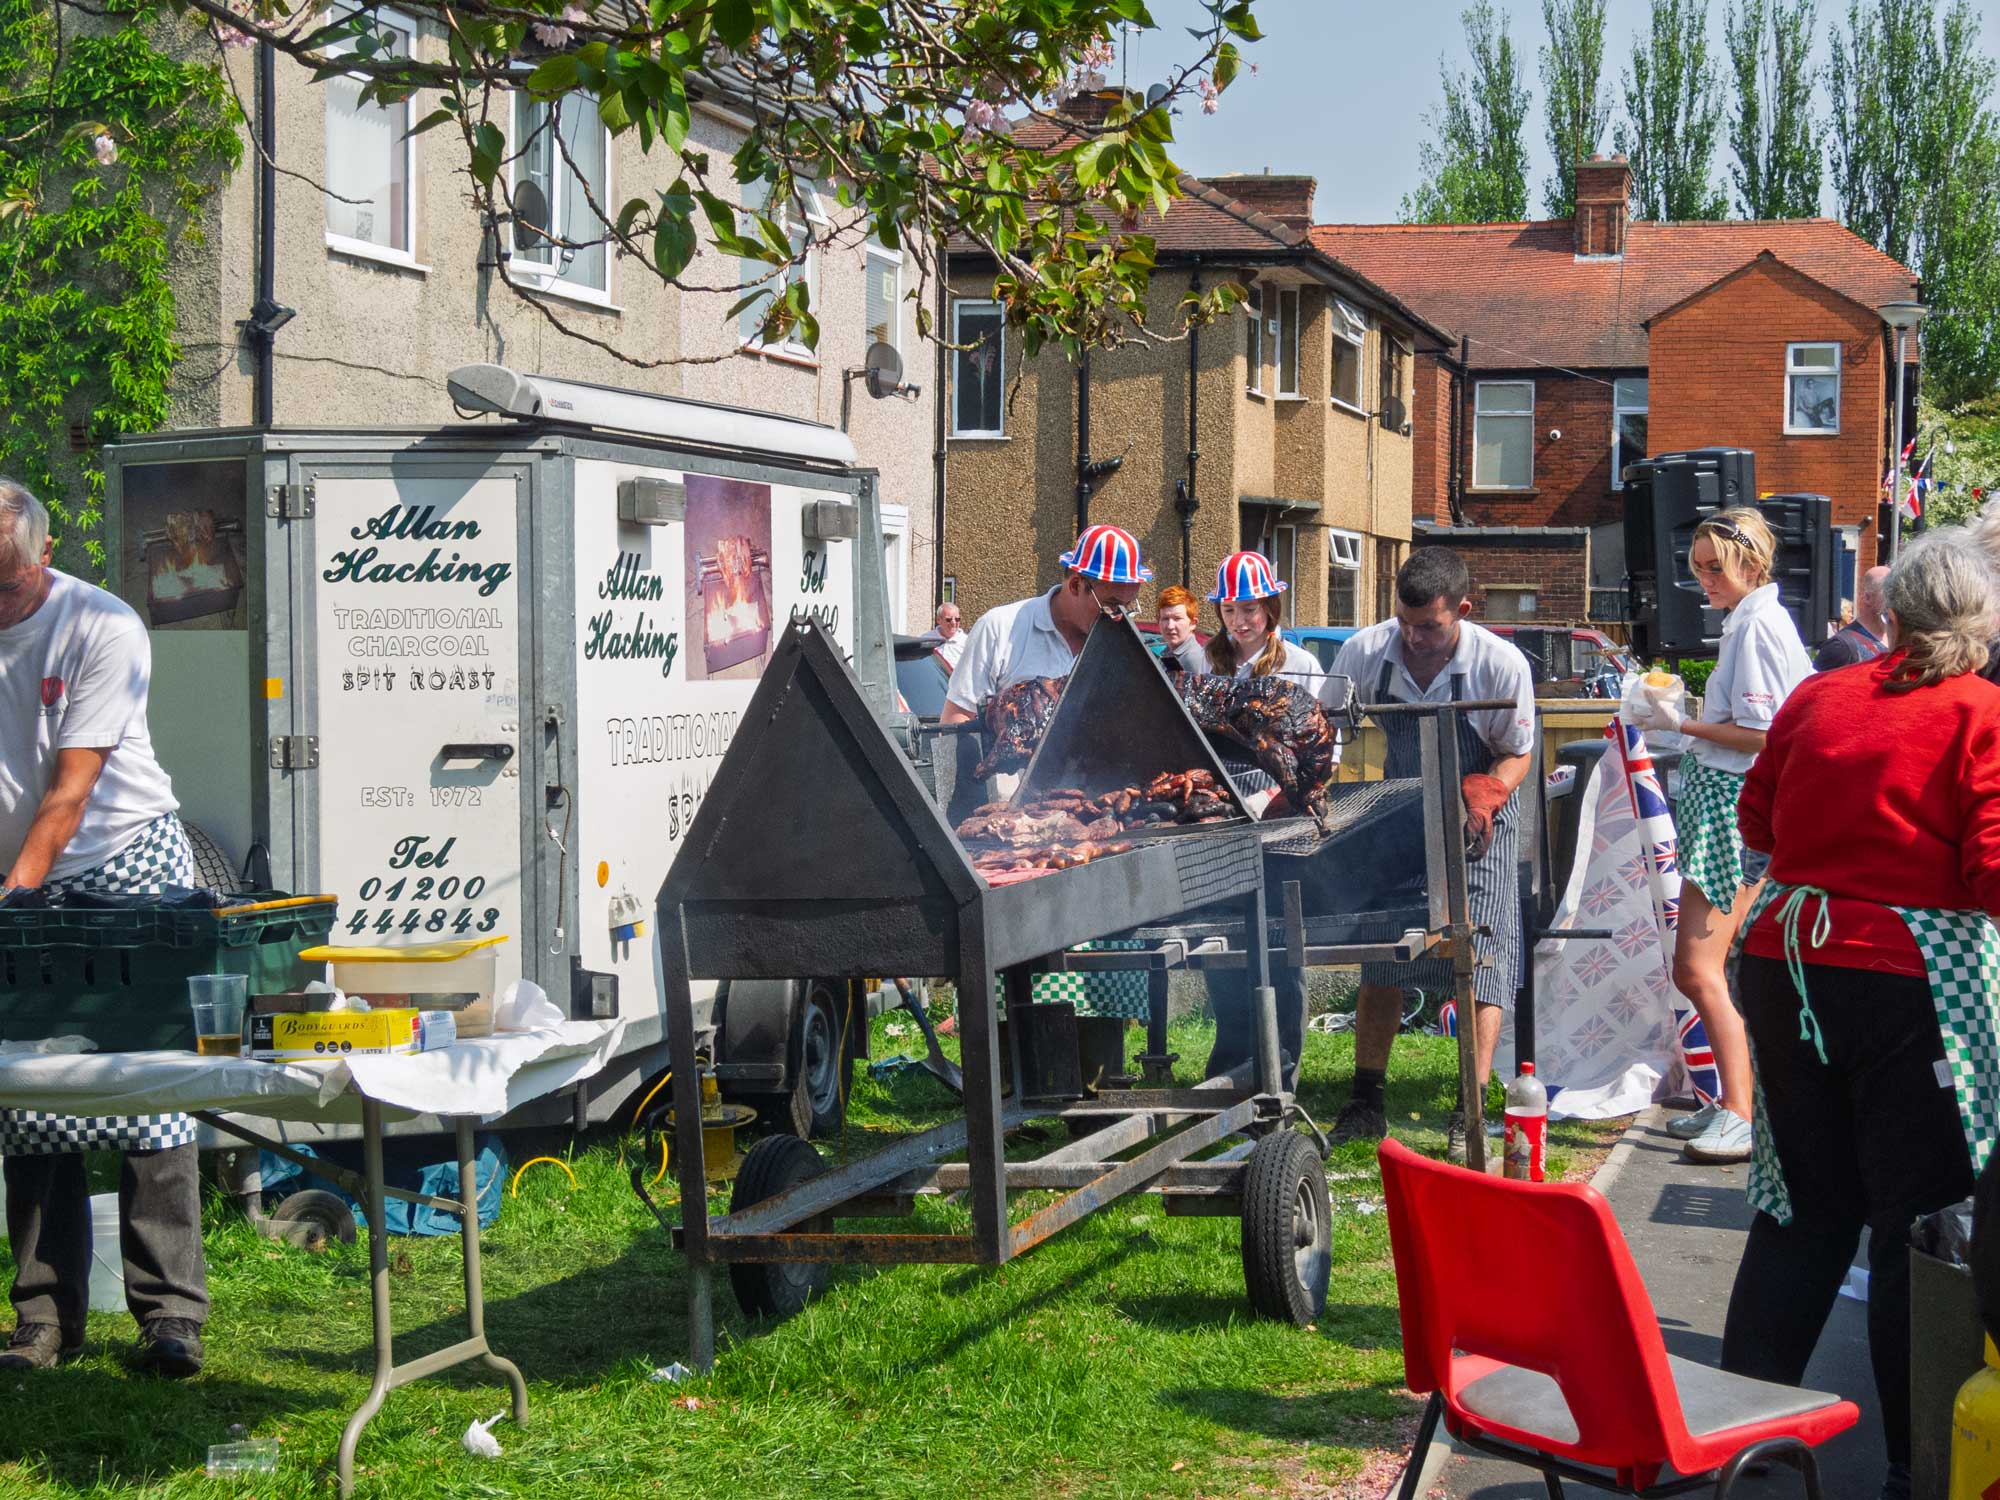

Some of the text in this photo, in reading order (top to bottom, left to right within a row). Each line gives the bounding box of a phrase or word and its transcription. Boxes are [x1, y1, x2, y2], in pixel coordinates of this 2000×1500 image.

[351, 504, 481, 540] Allan
[323, 547, 512, 597] Hacking
[599, 551, 663, 601] Allan
[801, 550, 827, 593] Tel
[334, 608, 503, 629] TRADITIONAL
[348, 636, 489, 657] CHARCOAL
[585, 610, 678, 678] Hacking
[342, 668, 495, 691] SPIT ROAST
[361, 786, 481, 807] EST: 1972
[389, 836, 457, 869] Tel
[359, 876, 485, 901] 01200
[345, 907, 500, 935] 444843
